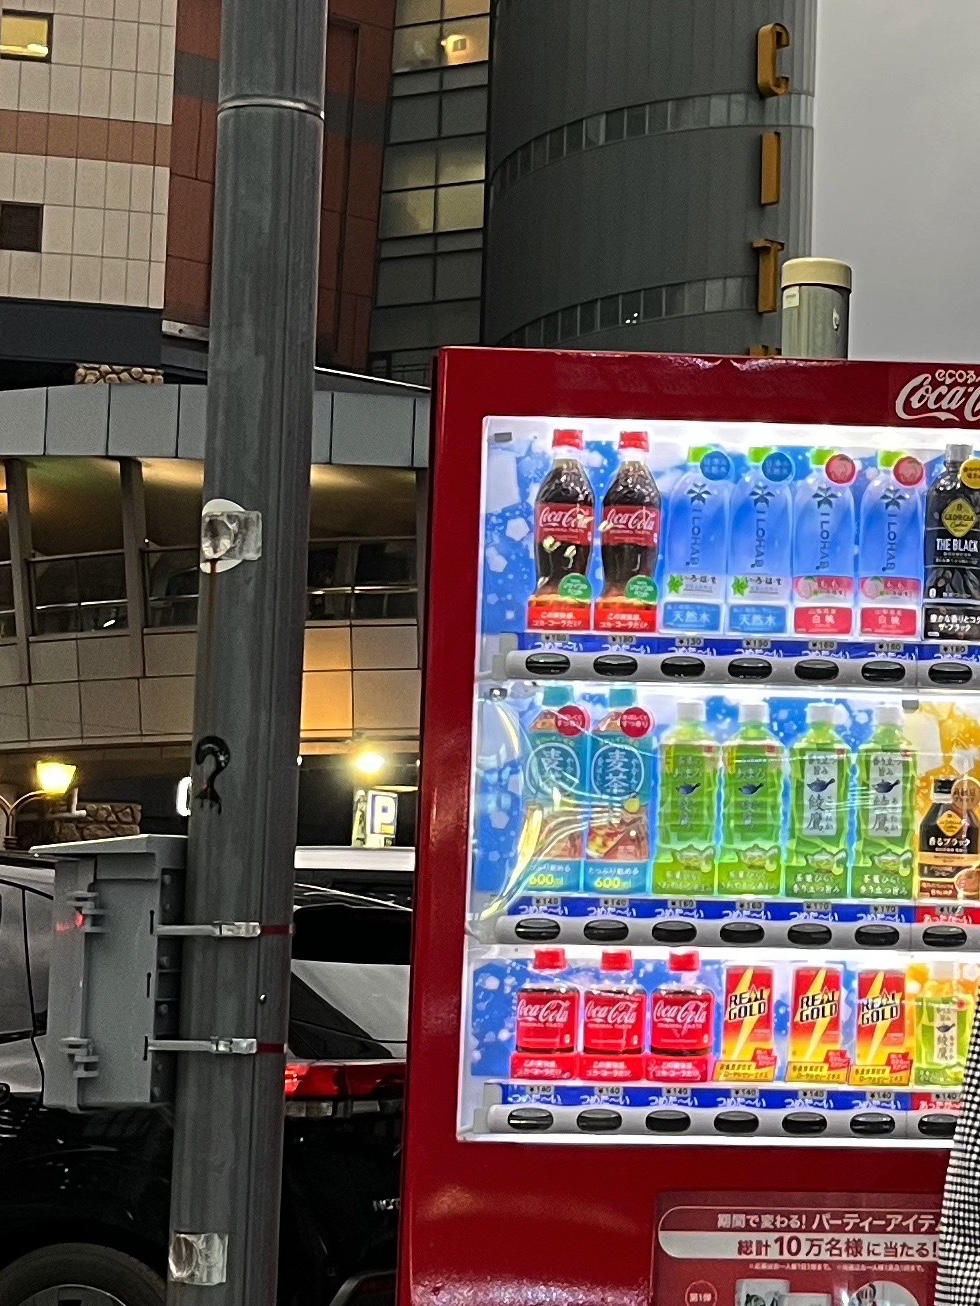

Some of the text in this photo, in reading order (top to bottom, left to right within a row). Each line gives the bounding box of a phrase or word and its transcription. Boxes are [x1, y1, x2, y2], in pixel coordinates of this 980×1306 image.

[749, 23, 790, 357] CIT
[936, 538, 979, 553] THE BLACK
[603, 748, 630, 795] 麦茶
[373, 794, 396, 834] P
[928, 836, 971, 848] 香るブラック
[728, 983, 767, 1008] REAL
[799, 985, 839, 1009] REAL
[861, 986, 897, 1011] REAL
[517, 999, 571, 1024] Coca-Cola
[585, 1000, 639, 1025] Coca-Cola
[653, 1000, 707, 1024] Coca-Cola
[727, 1000, 767, 1022] GOLD
[799, 1003, 839, 1023] GOLD
[861, 1005, 899, 1026] GOLD
[717, 1213, 806, 1230] 期間で変わる!
[737, 1234, 938, 1258] 総計10万名様に当たる!
